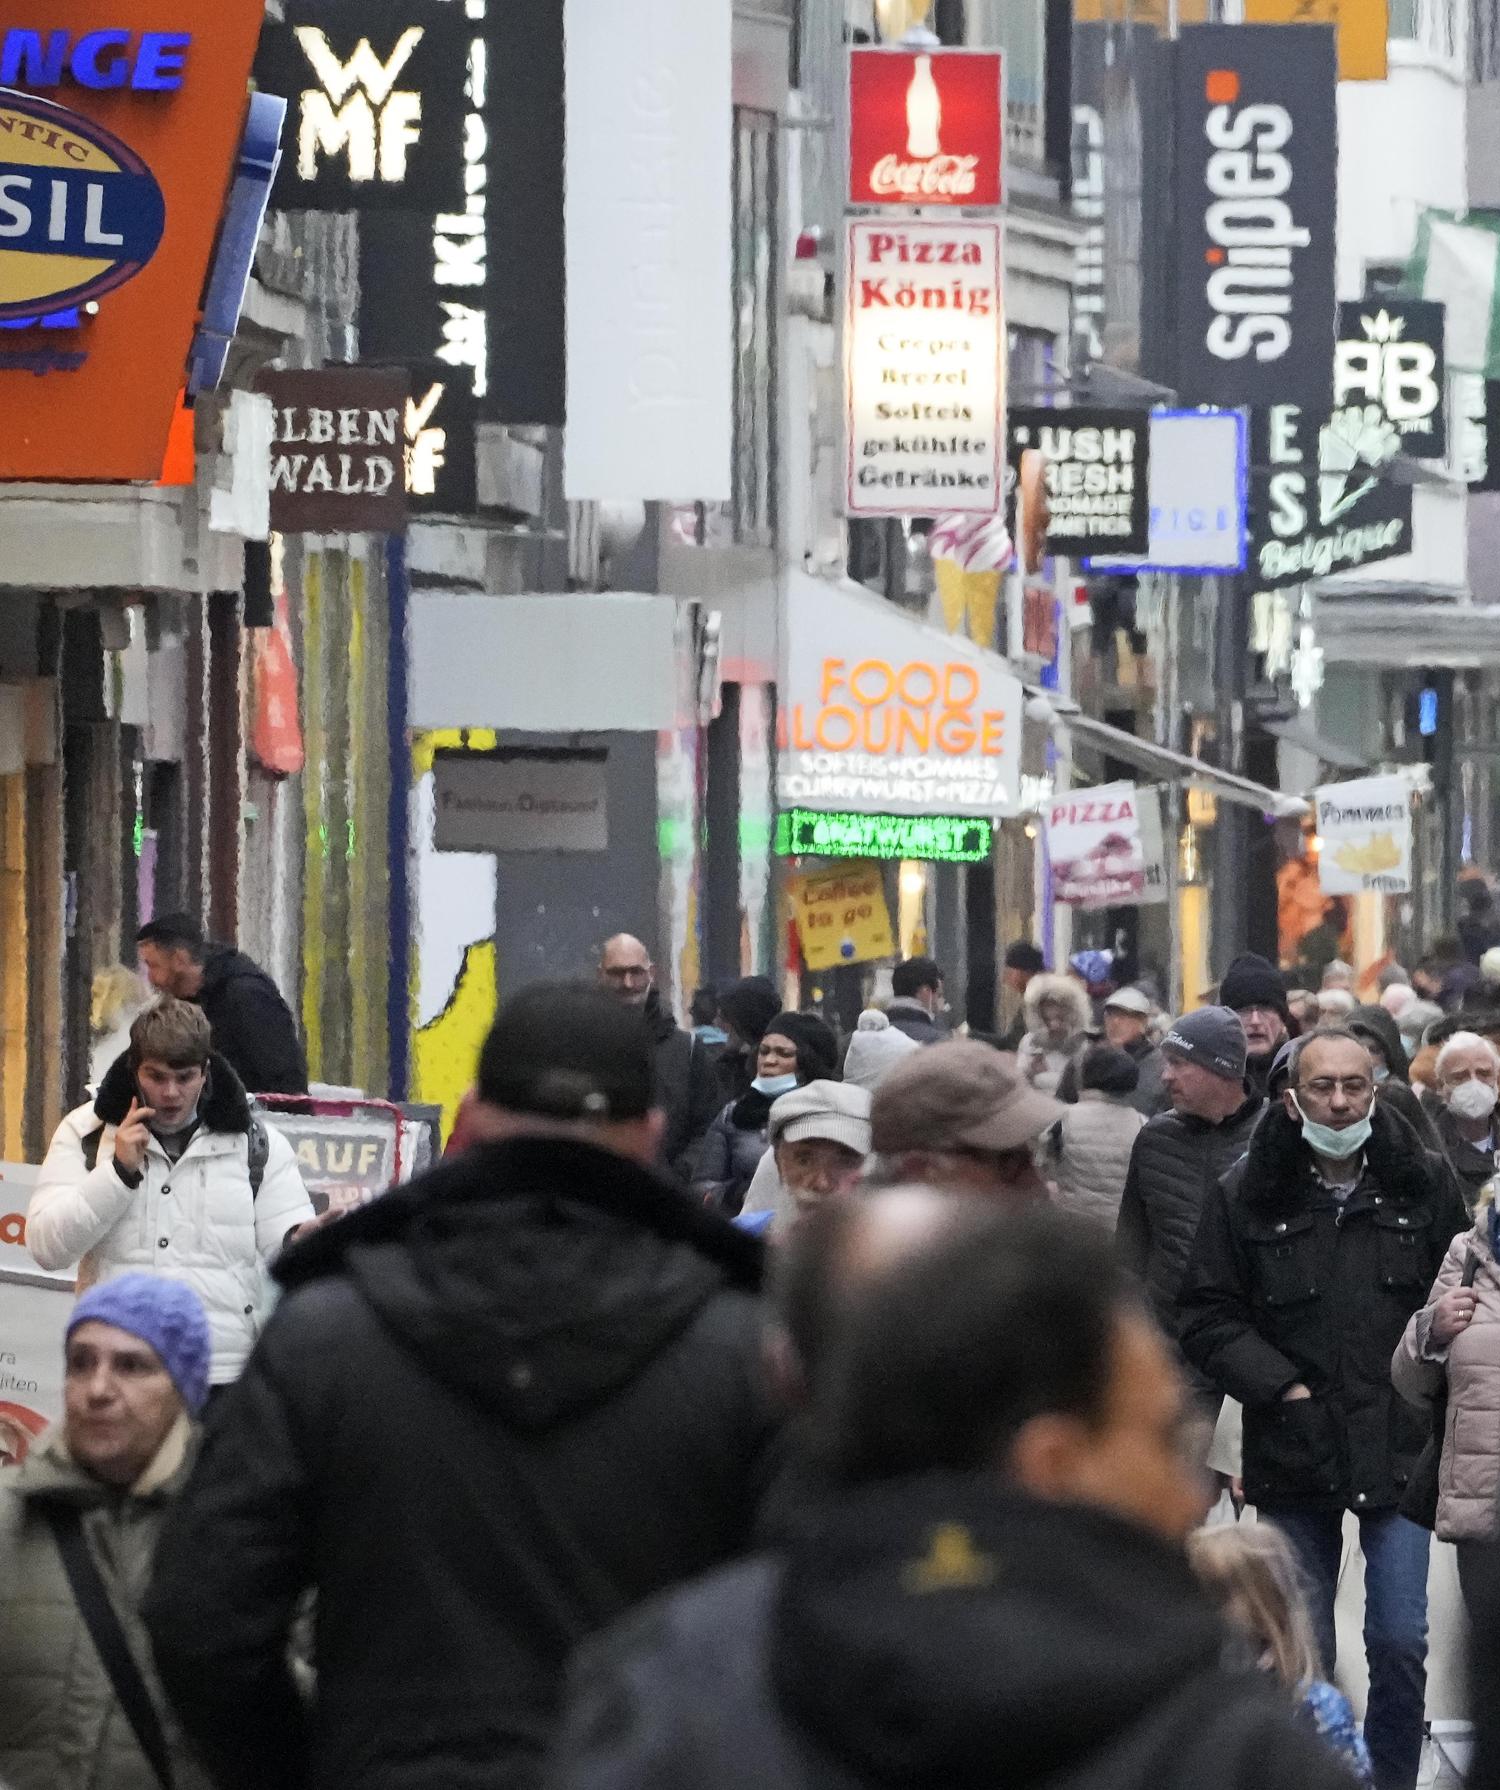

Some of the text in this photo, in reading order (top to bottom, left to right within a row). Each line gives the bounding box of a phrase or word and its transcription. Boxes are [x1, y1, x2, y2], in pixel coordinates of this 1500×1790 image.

[867, 233, 982, 265] Pizza
[1204, 102, 1311, 362] snipes
[861, 278, 990, 315] König
[876, 402, 972, 420] Softeis
[858, 466, 989, 489] Getränke
[820, 657, 980, 711] FOOD
[792, 703, 1006, 757] LOUNGE
[1050, 801, 1134, 828] PIZZA
